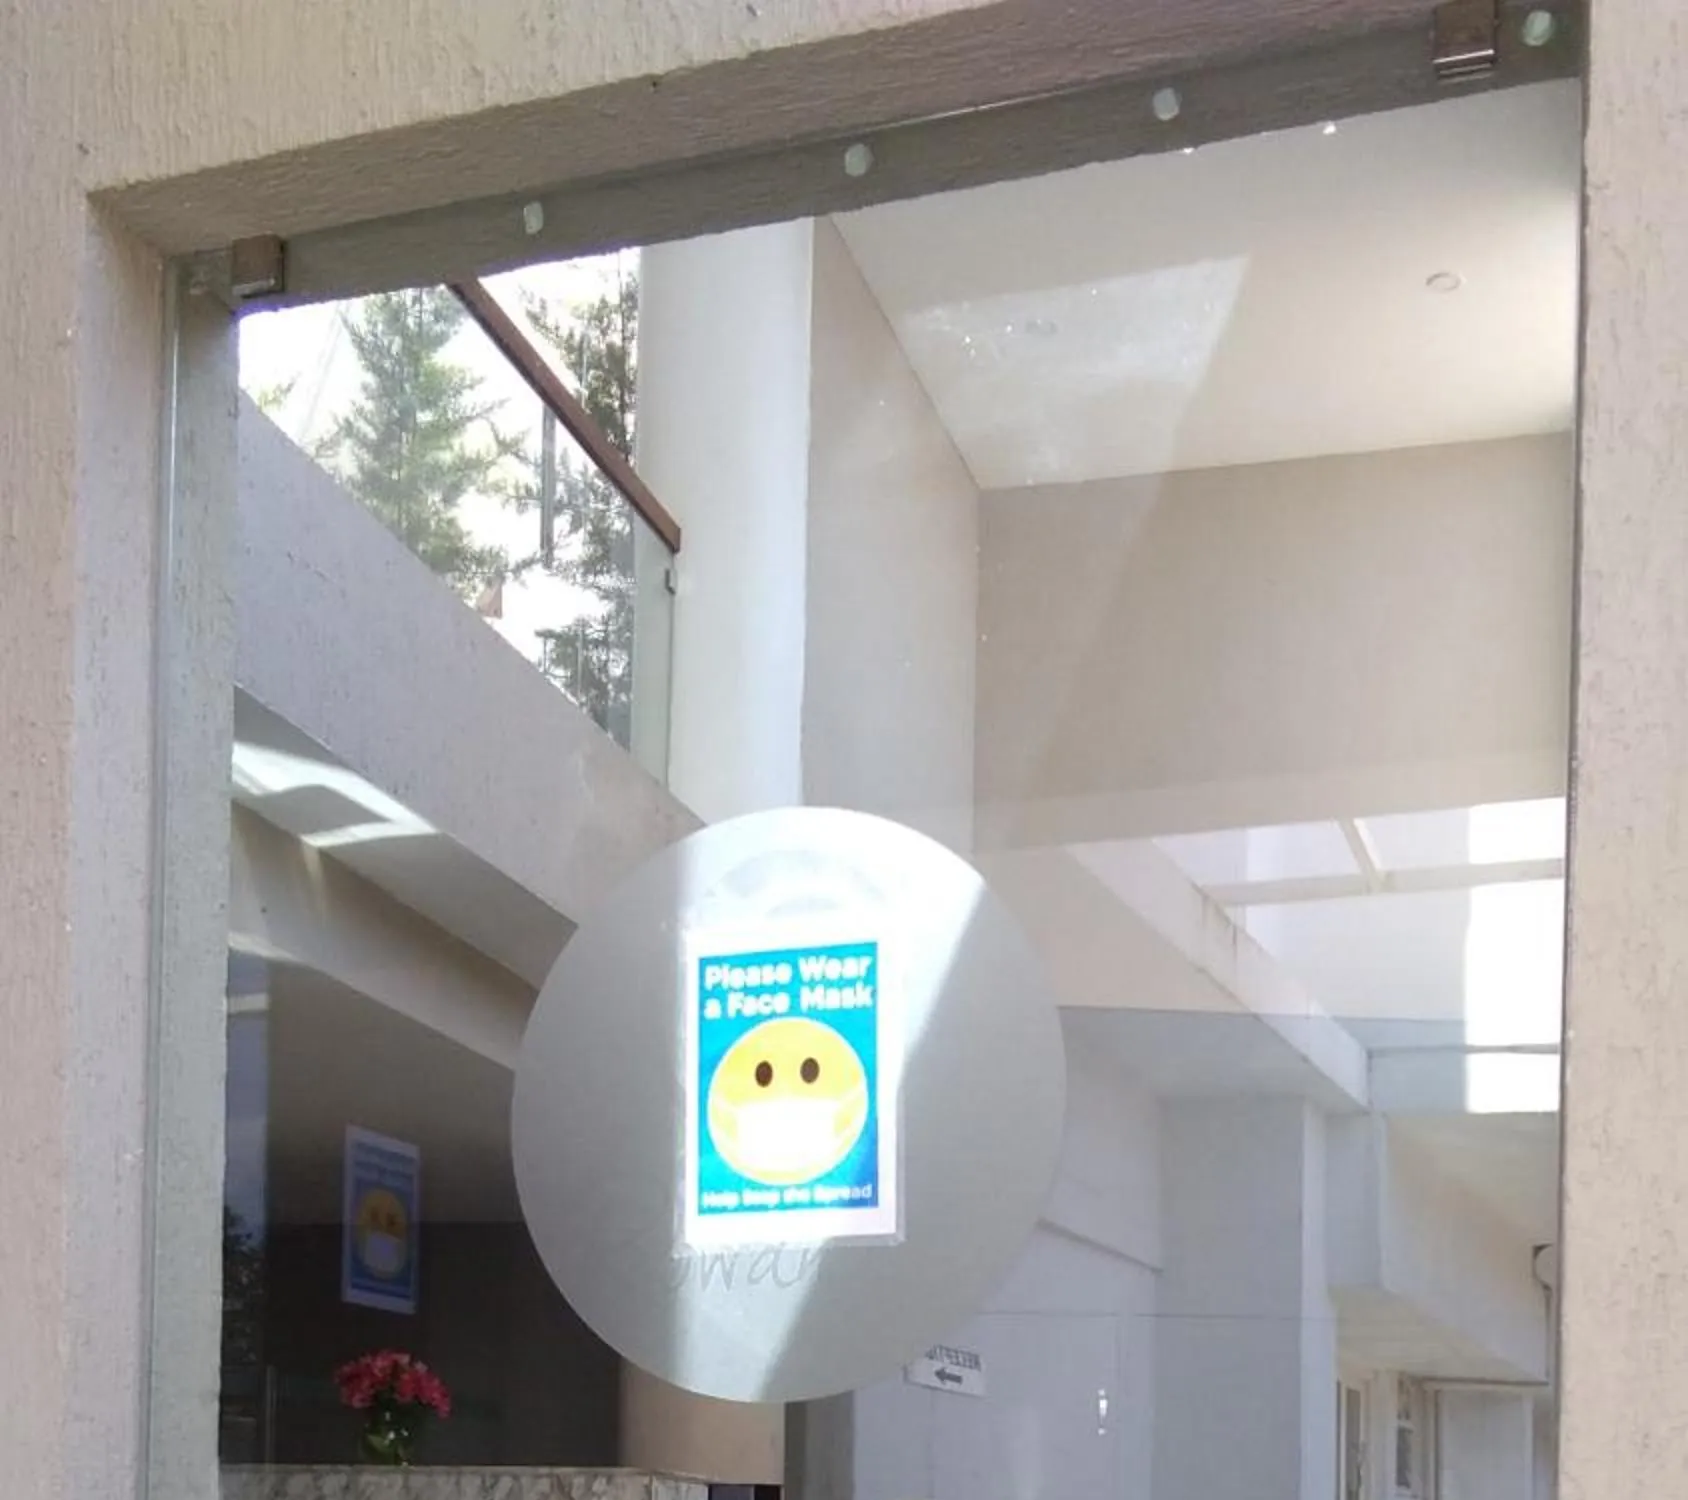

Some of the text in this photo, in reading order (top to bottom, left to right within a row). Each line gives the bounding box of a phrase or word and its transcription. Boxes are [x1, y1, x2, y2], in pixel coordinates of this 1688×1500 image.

[704, 955, 872, 990] Please Wear
[704, 980, 873, 1019] a Face Mask
